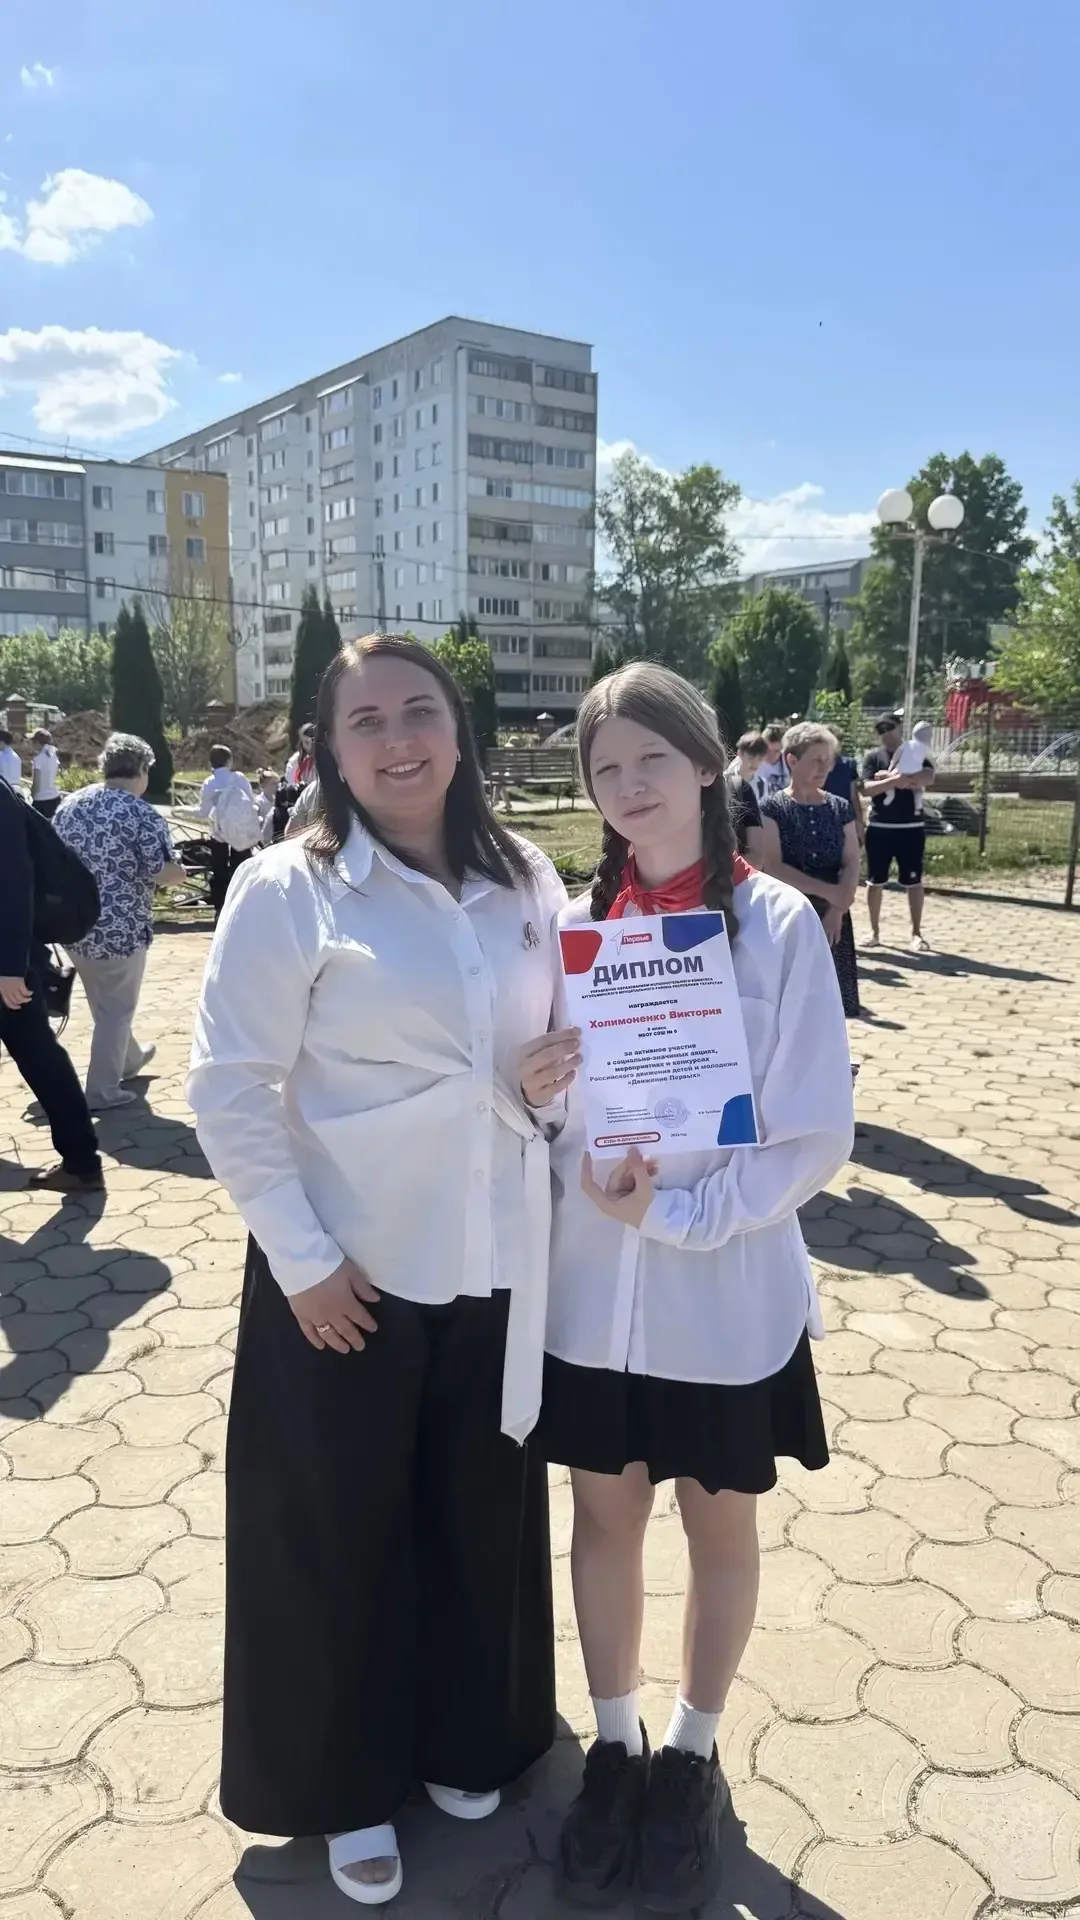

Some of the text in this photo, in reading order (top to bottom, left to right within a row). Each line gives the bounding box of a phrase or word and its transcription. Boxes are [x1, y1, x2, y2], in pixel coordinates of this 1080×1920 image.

[624, 935, 650, 944] Первые
[592, 956, 704, 987] ДИПЛОМ
[628, 999, 678, 1009] награждается
[590, 1008, 722, 1029] Холимоненко Виктория
[634, 1047, 666, 1055] активное
[668, 1044, 696, 1052] участие
[613, 1052, 688, 1065] социально-значимых
[615, 1062, 664, 1072] мероприятиях
[672, 1057, 710, 1065] конкурсах
[590, 1073, 634, 1082] Российского
[636, 1069, 670, 1077] движения
[672, 1065, 693, 1074] детей
[628, 1077, 668, 1085] «Движение
